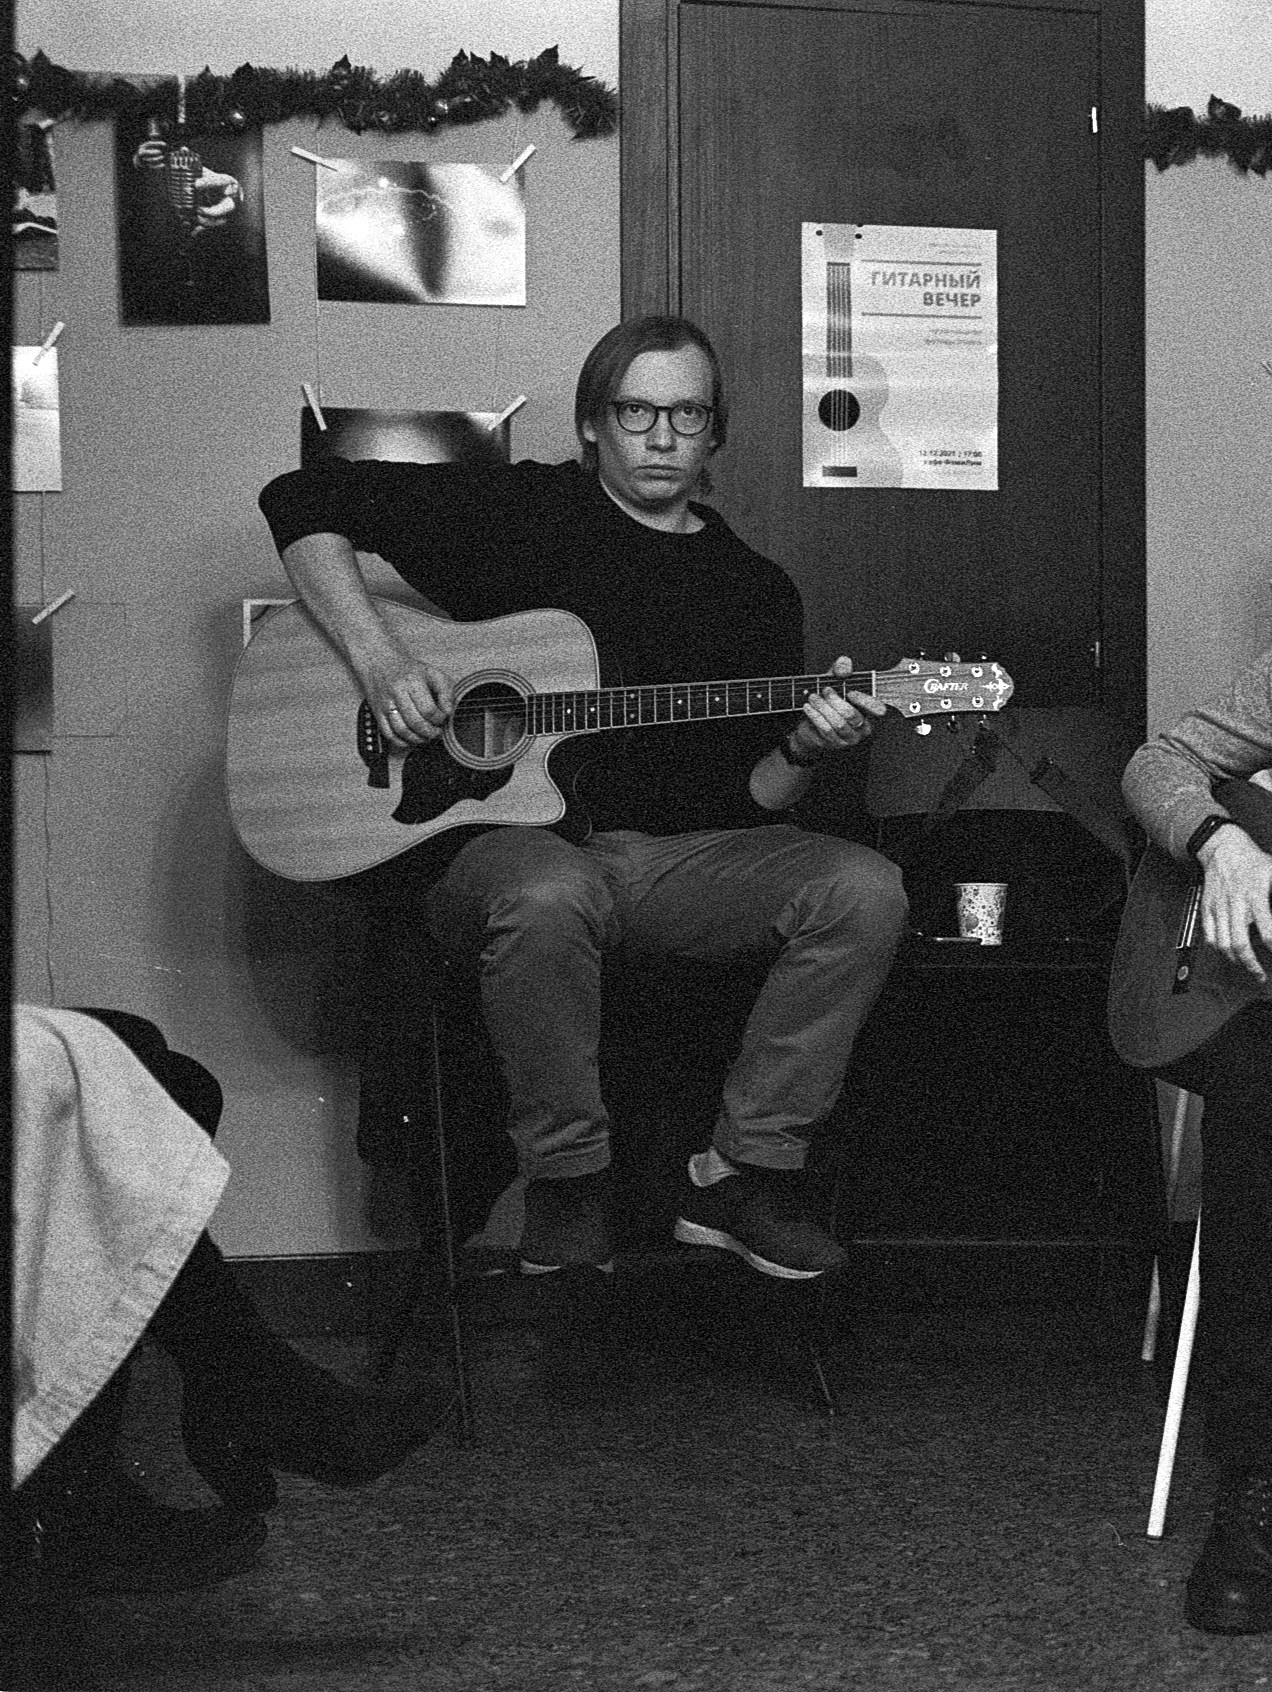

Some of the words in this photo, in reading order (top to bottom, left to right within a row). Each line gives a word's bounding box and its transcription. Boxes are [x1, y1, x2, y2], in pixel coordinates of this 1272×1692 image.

[871, 270, 981, 289] ГИТАРНЫЙ
[922, 291, 981, 307] ВЕЧЕР
[923, 679, 969, 694] CRAFTER
